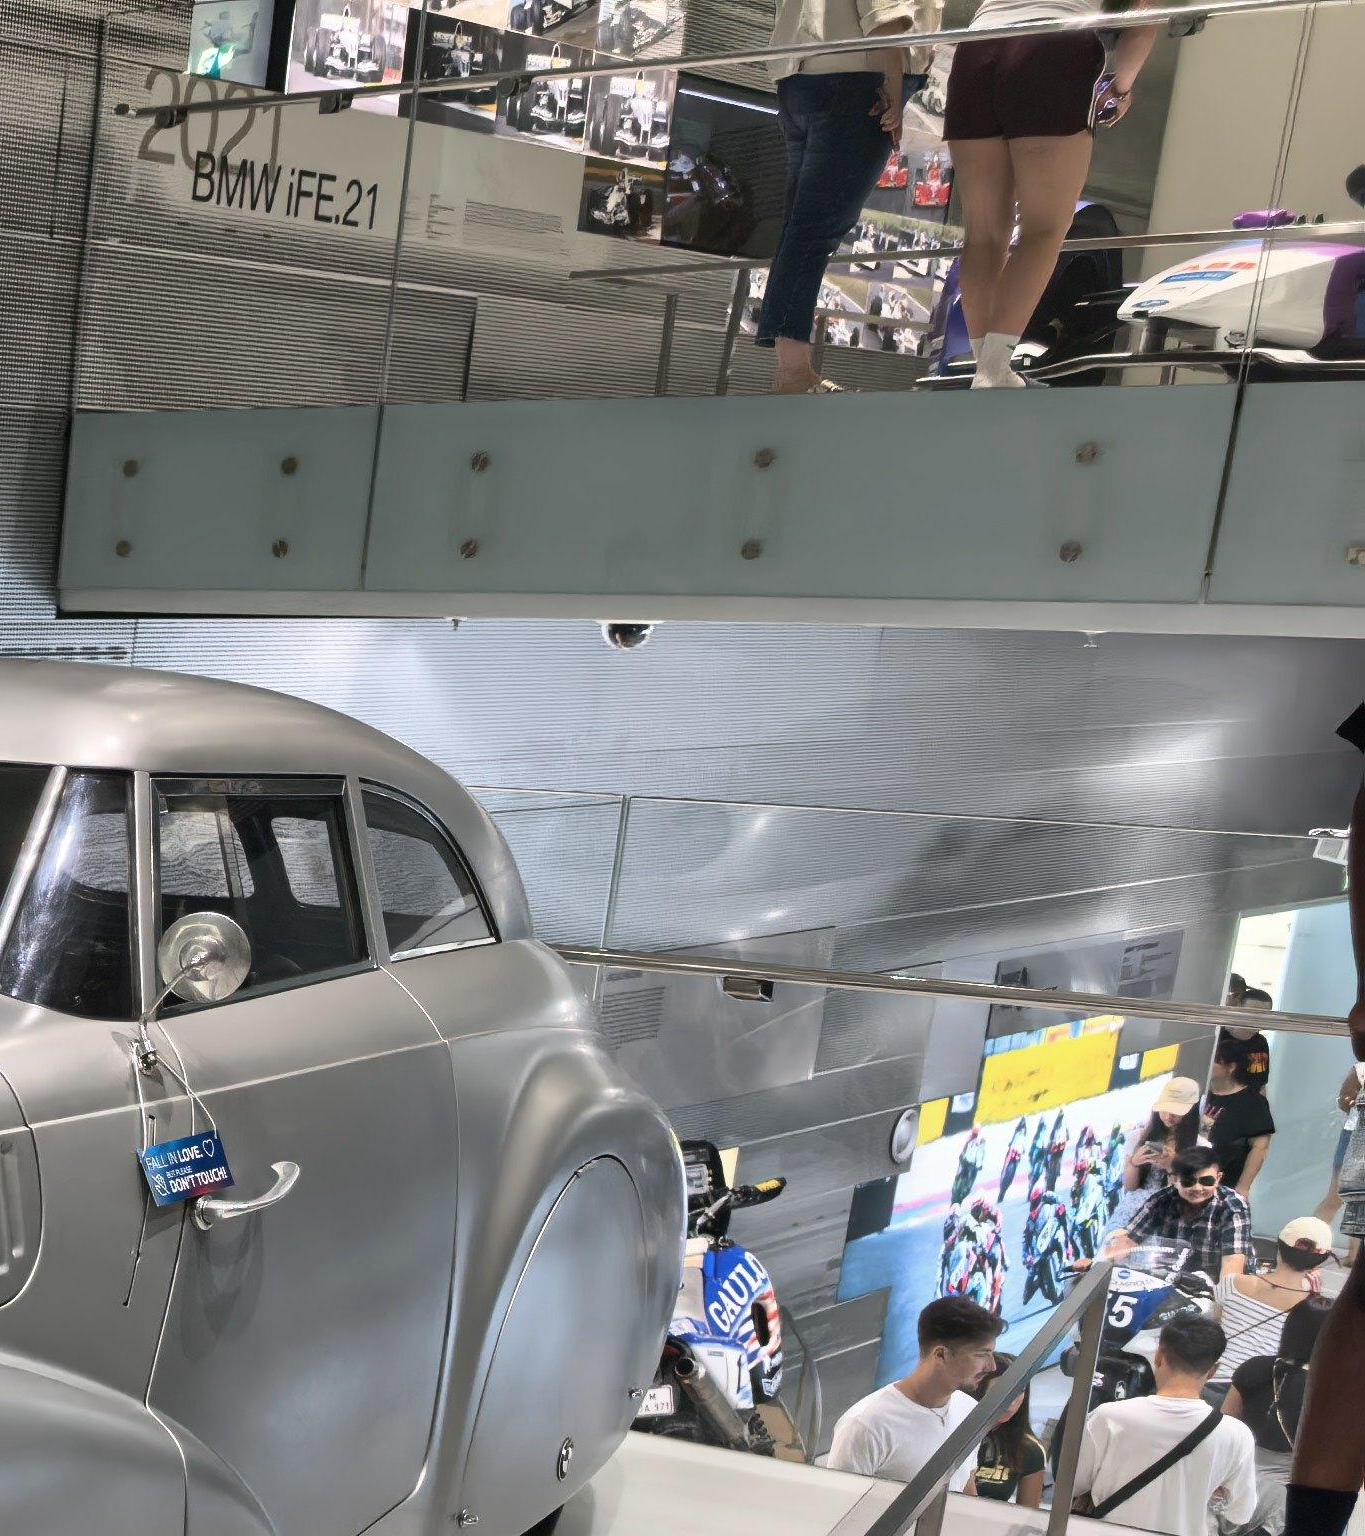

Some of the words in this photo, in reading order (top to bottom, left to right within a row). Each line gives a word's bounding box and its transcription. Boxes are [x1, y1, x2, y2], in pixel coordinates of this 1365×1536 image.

[137, 66, 282, 183] 2021
[191, 150, 282, 214] BMW
[285, 167, 379, 230] iFE.21
[145, 1154, 169, 1171] FALL
[166, 1150, 179, 1165] IN
[177, 1145, 204, 1162] LOVE.
[169, 1175, 195, 1193] DON'T
[194, 1166, 228, 1186] TOUCH!
[1107, 1293, 1139, 1328] 5
